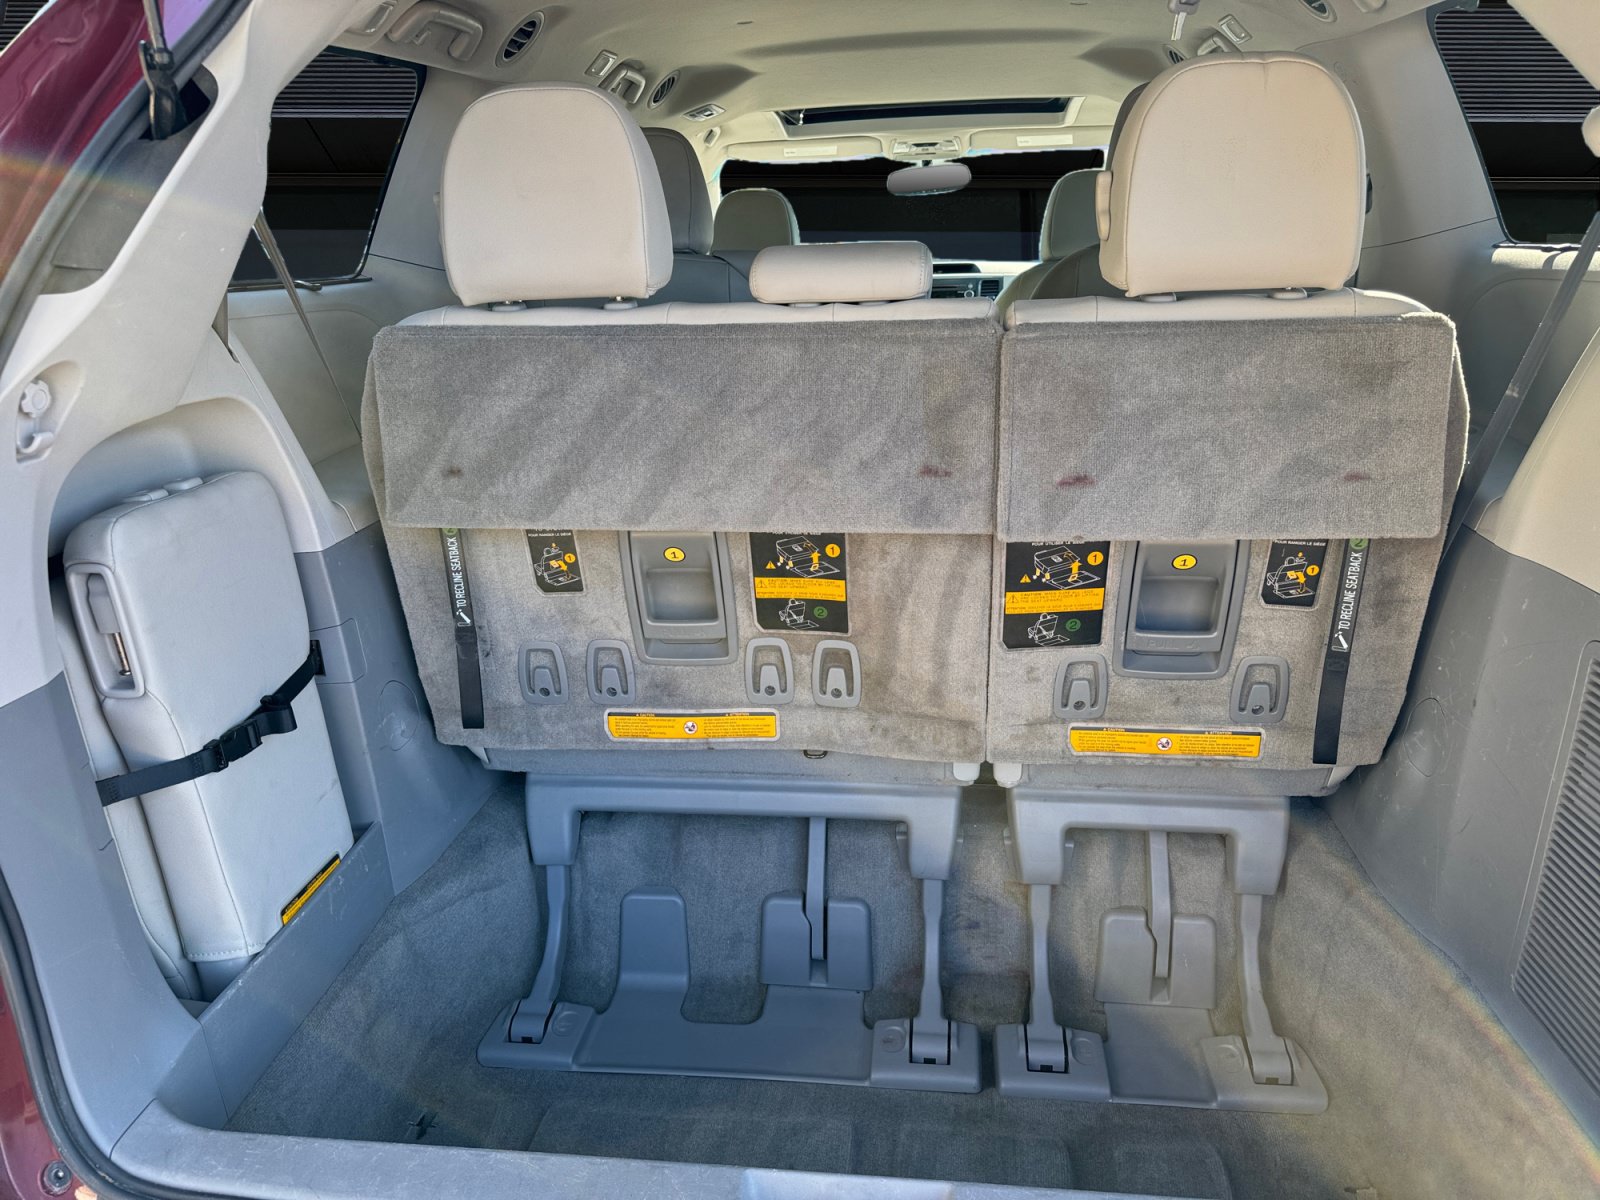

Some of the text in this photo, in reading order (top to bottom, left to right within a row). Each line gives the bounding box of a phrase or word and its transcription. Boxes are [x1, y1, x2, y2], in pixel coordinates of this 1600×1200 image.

[447, 537, 462, 570] SEATBACK
[452, 572, 465, 598] RECLINE
[1338, 551, 1363, 630] TO RECLINE SEATBACK
[456, 600, 466, 608] TO
